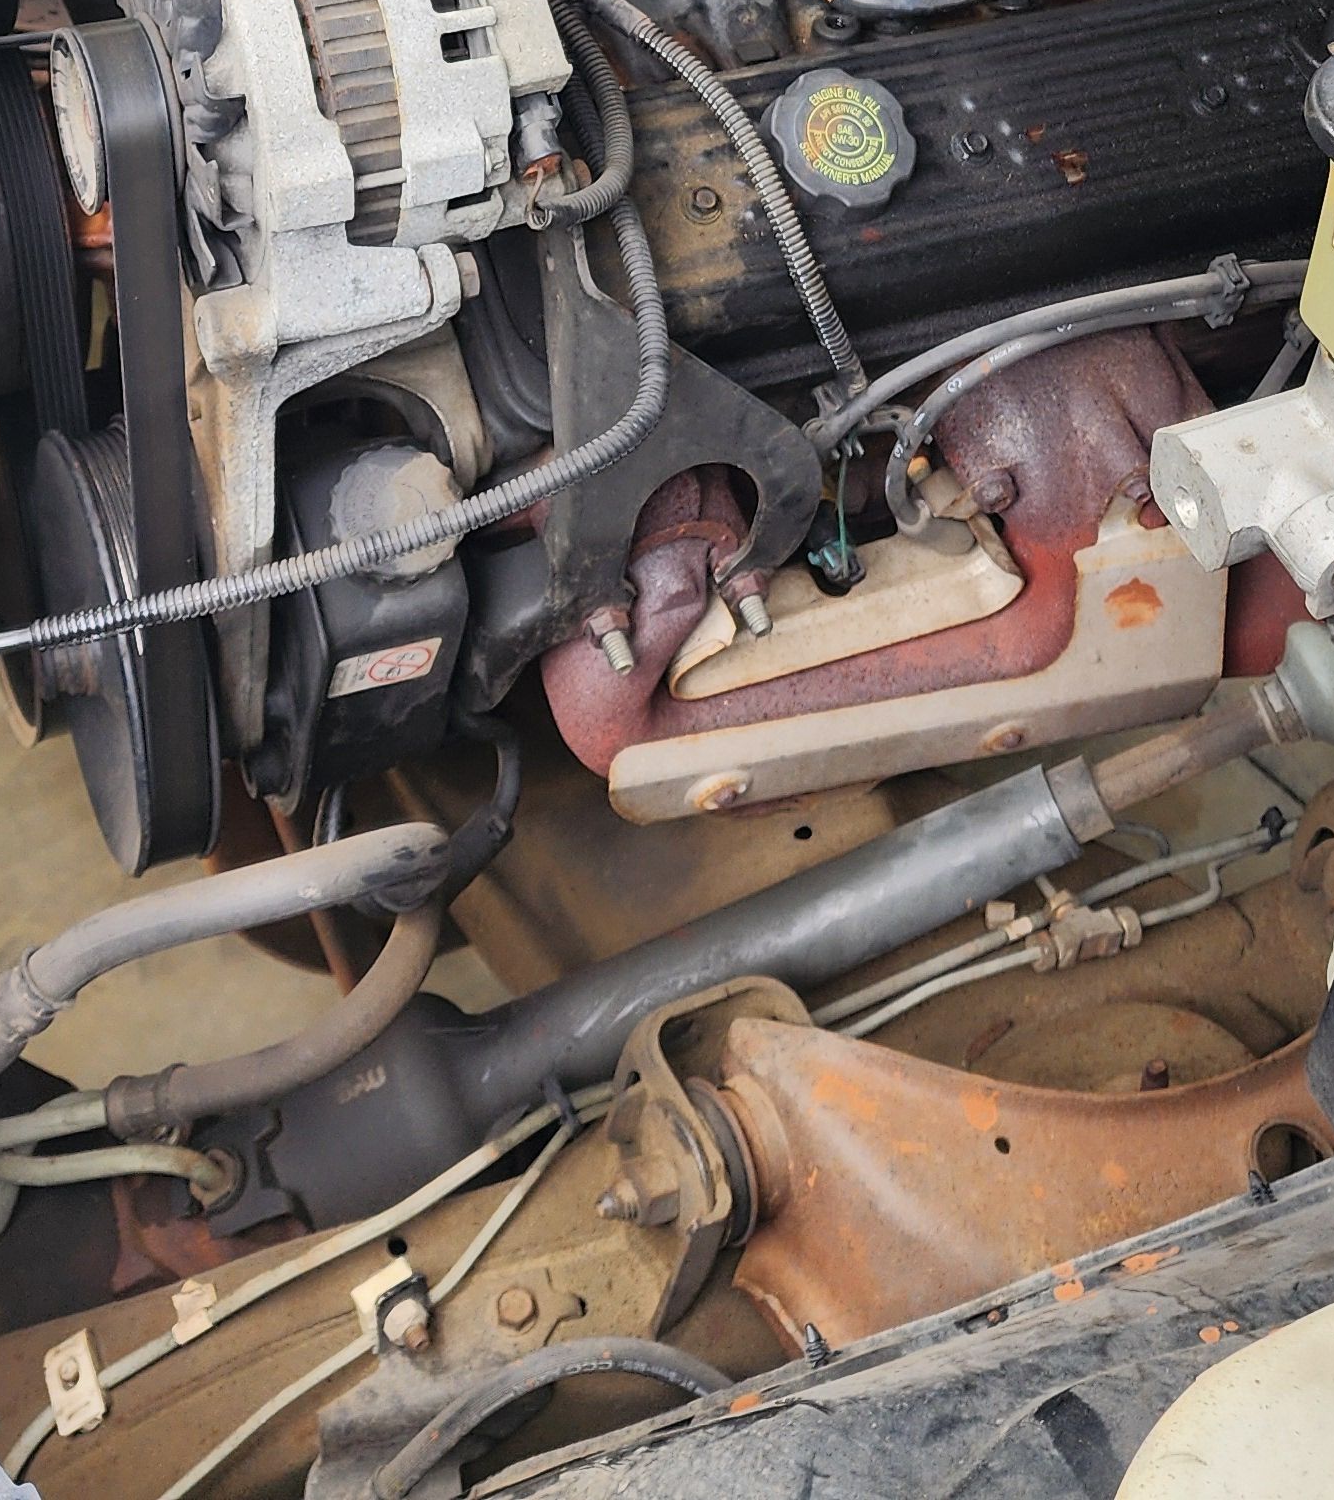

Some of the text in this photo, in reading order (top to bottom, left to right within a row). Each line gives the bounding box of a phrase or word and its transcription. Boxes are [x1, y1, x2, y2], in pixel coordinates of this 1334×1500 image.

[809, 86, 882, 115] ENGINE OIL FILL
[830, 103, 862, 118] SERVICE
[831, 133, 860, 147] 5W-30
[799, 141, 896, 185] SEE OWNER'S MANUAL
